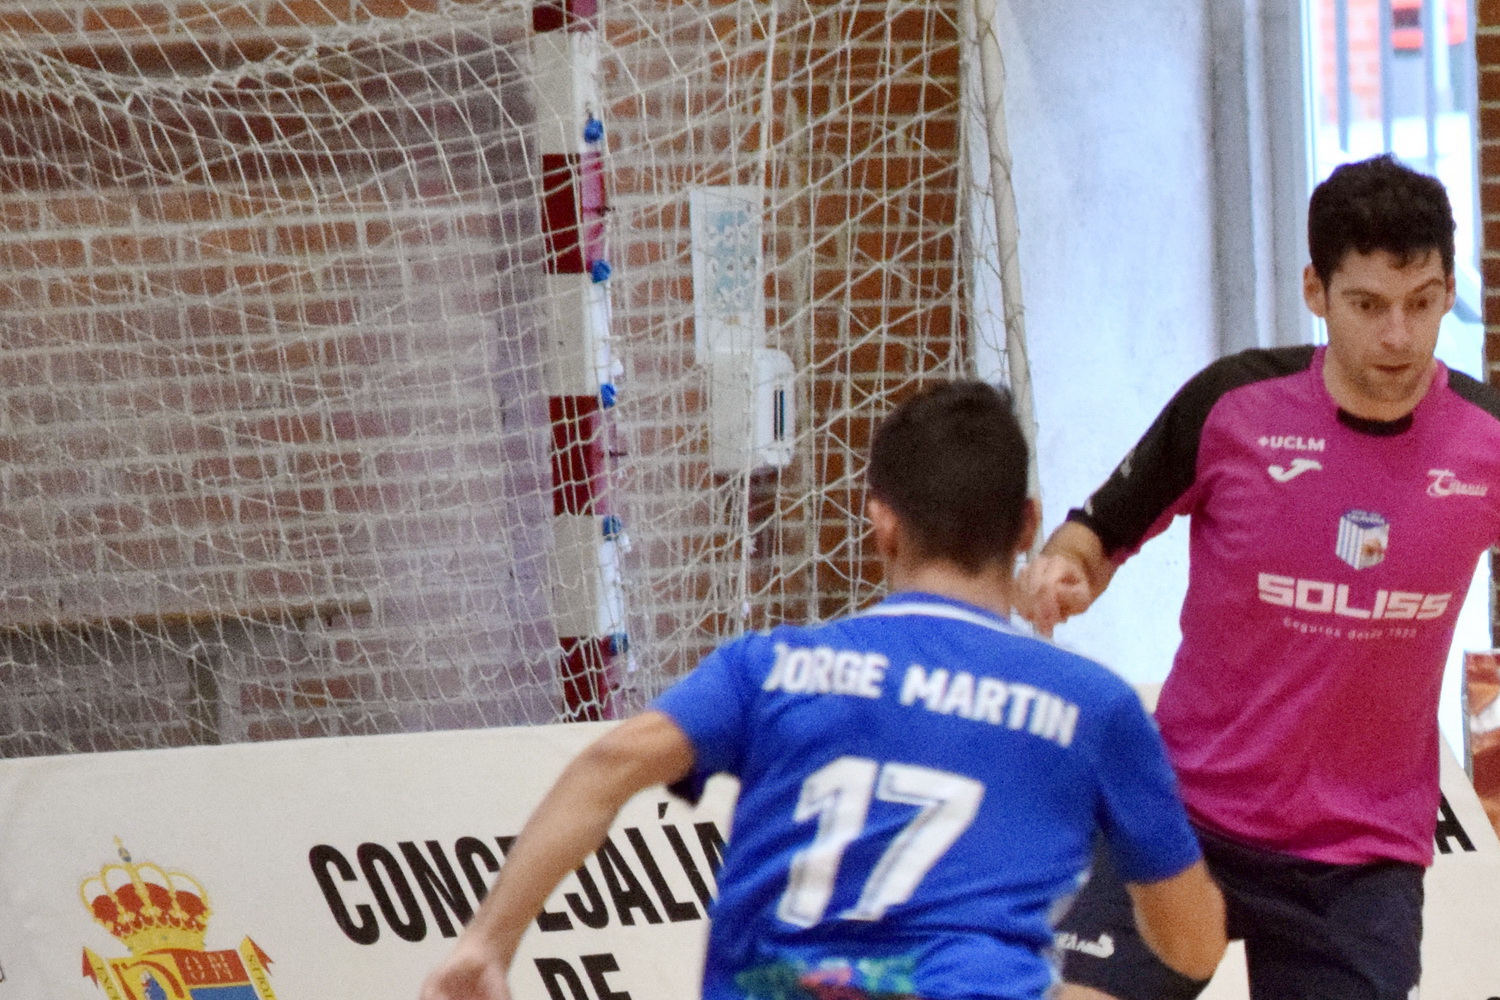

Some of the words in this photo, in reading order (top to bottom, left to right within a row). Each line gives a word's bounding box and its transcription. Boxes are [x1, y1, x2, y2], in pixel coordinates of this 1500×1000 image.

[1257, 571, 1453, 621] SOLISS
[764, 643, 890, 700] JORGE
[899, 663, 1080, 749] MARTIN
[776, 754, 985, 929] 17
